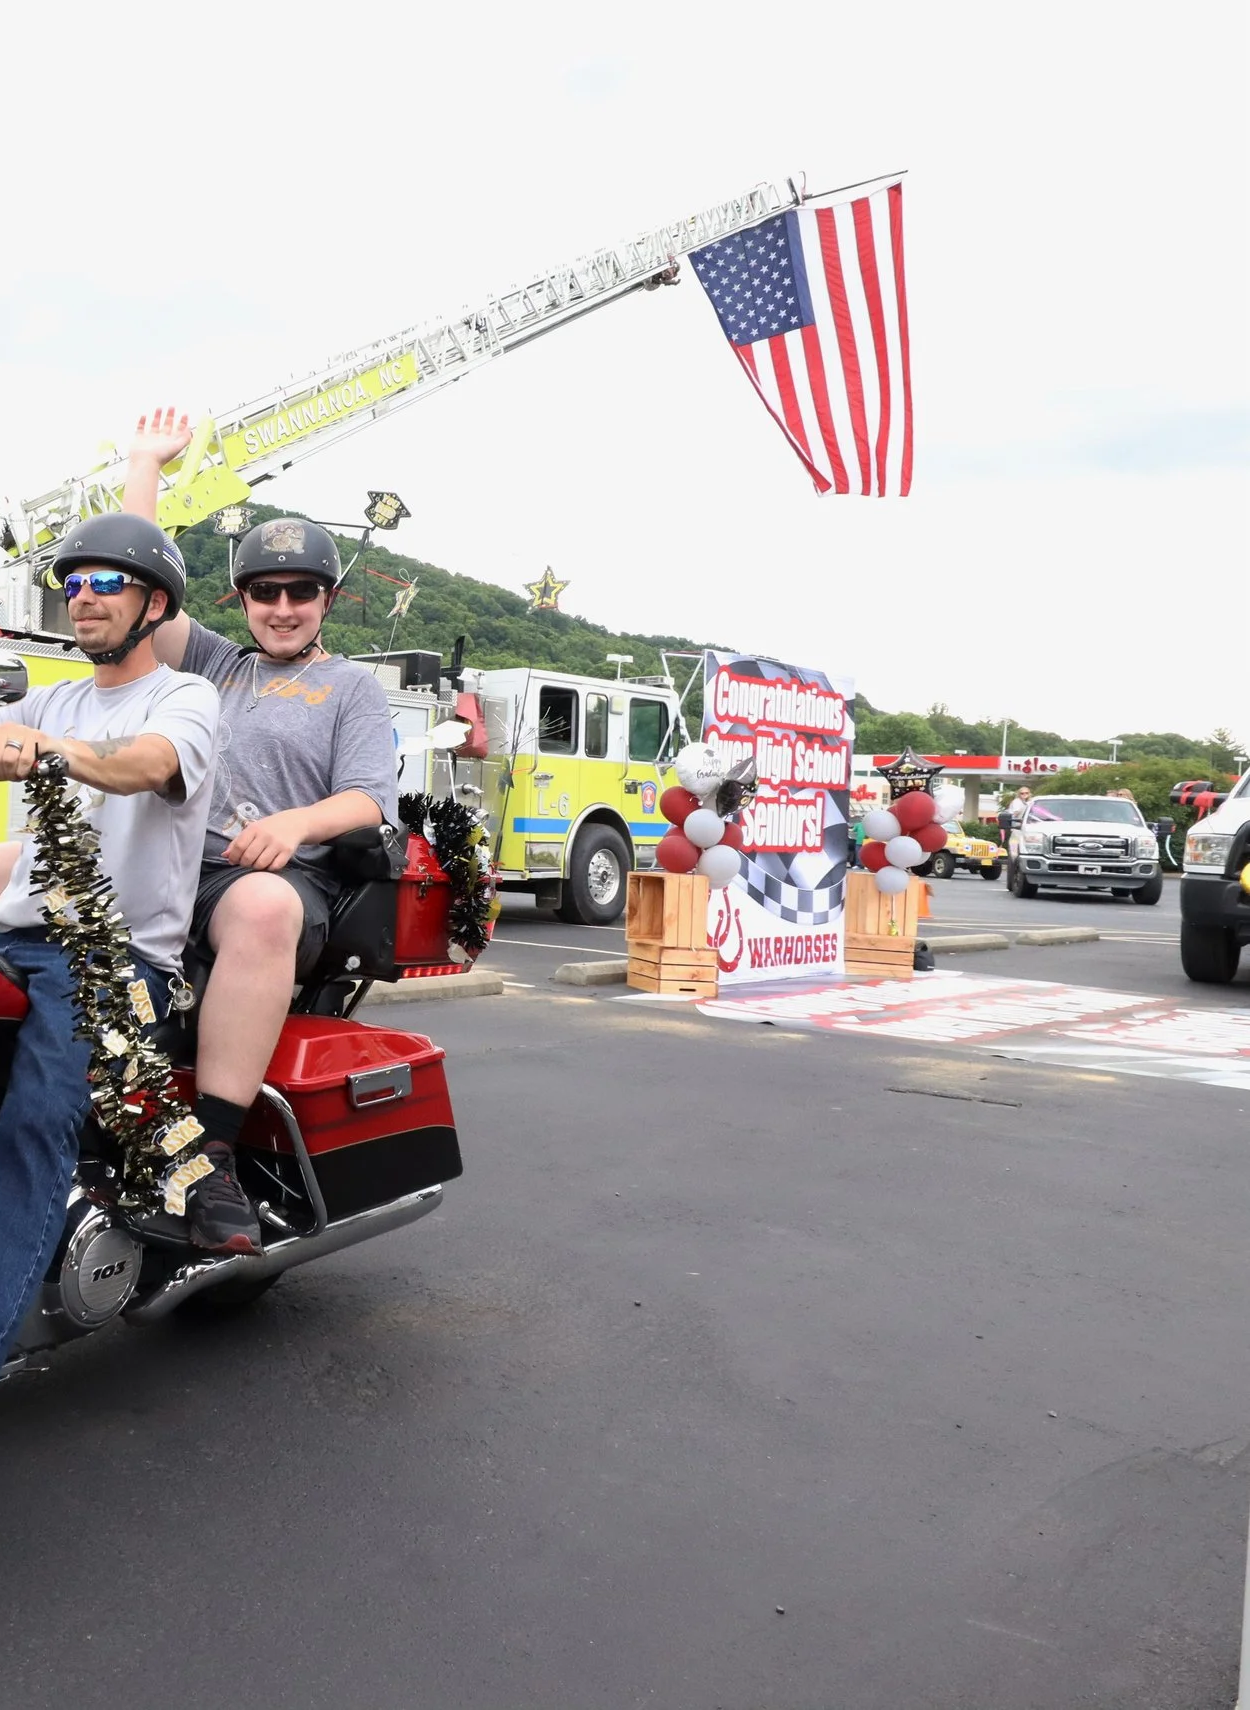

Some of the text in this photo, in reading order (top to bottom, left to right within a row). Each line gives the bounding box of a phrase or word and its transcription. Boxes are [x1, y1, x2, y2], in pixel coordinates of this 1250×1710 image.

[244, 361, 404, 455] SWANNANOA, NC
[716, 671, 844, 732] Congratulations
[756, 736, 792, 785] High
[794, 740, 847, 784] School
[1007, 757, 1058, 773] ingles
[538, 790, 570, 817] L-6
[742, 795, 824, 847] Seniors!
[747, 933, 838, 968] WARHORSES
[92, 1260, 127, 1282] 103
